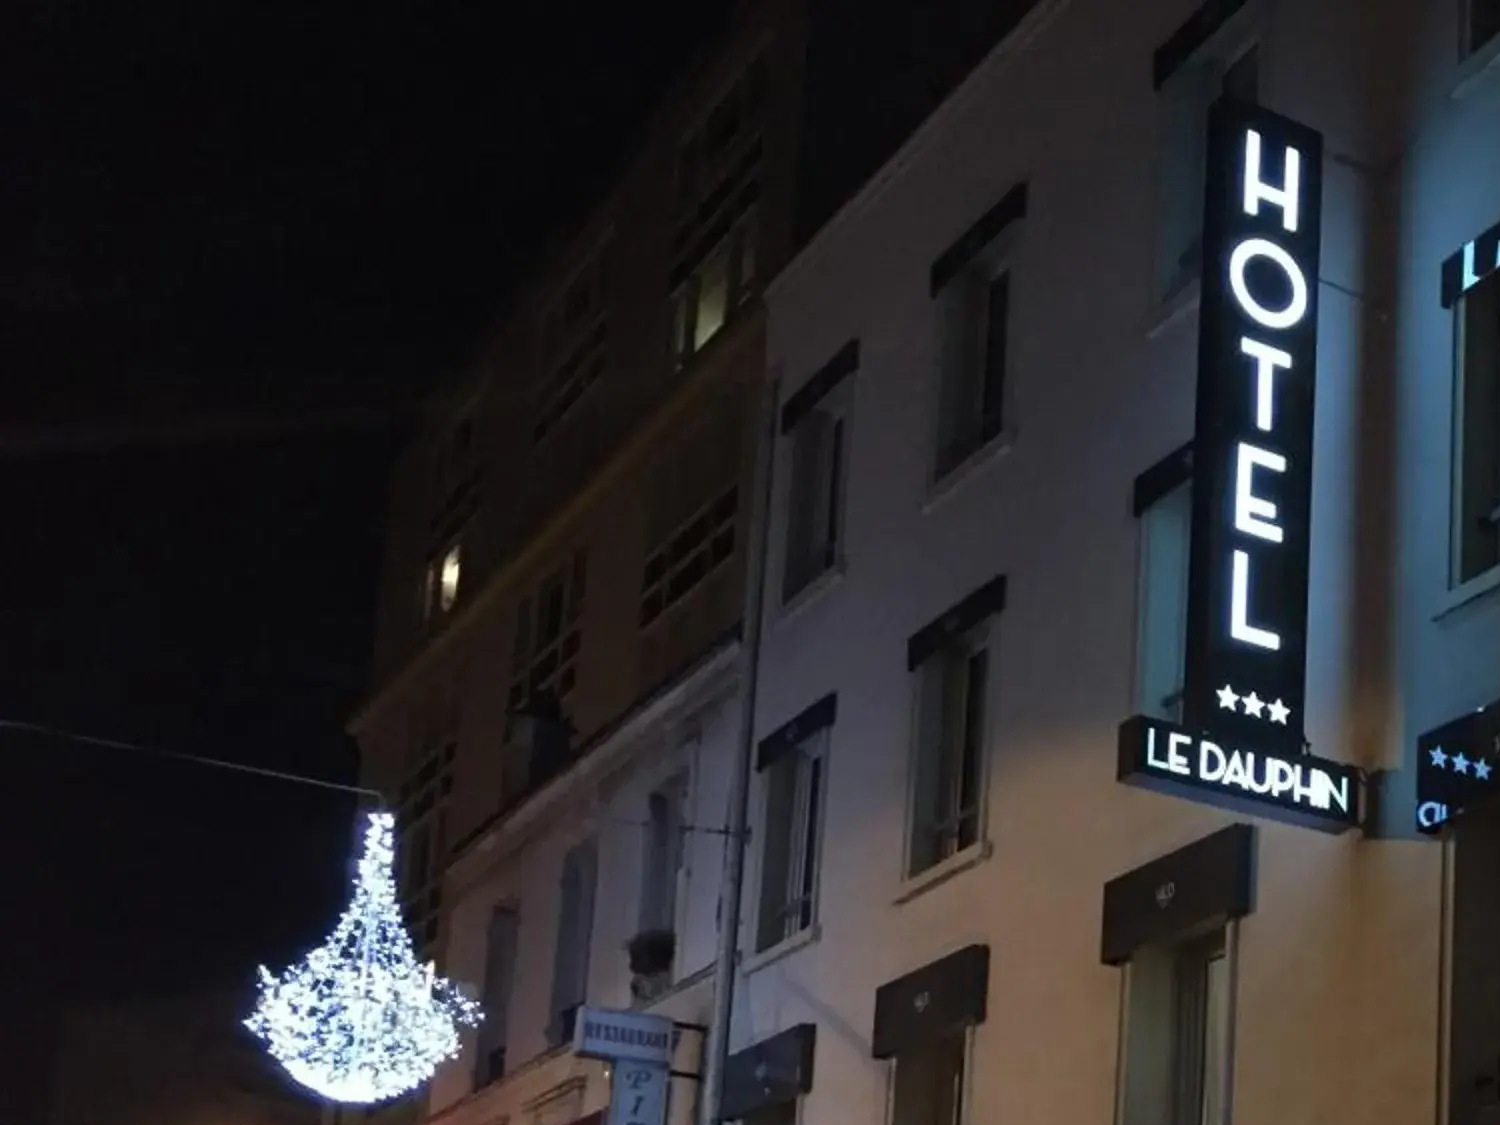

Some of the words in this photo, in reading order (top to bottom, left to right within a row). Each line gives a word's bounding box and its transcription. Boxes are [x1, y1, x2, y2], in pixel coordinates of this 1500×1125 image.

[1229, 129, 1308, 651] HOTEL
[1147, 727, 1193, 776] LE
[1199, 739, 1349, 813] DAUPHIN
